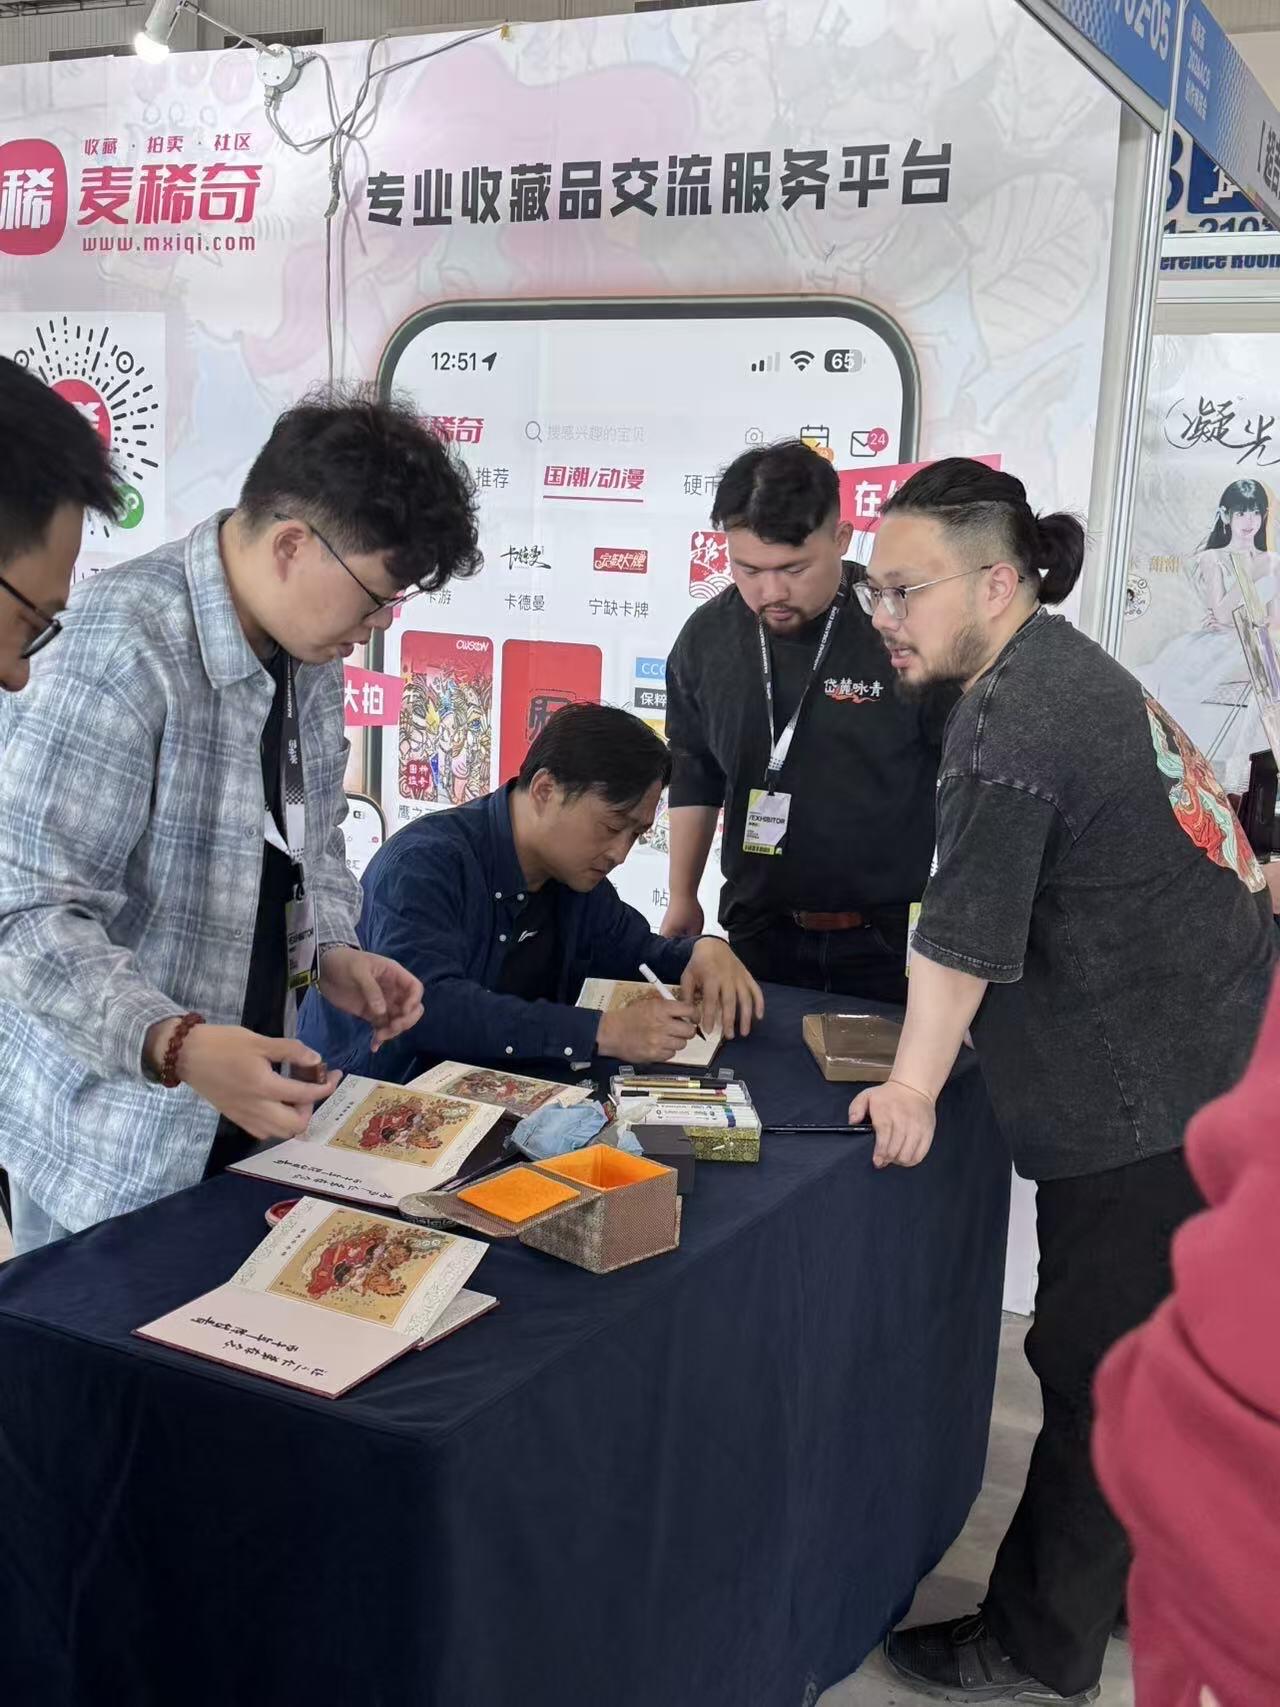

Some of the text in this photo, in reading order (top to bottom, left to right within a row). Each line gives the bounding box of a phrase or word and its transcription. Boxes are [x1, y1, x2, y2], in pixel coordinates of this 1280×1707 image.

[84, 133, 251, 155] 收藏 拍卖 社区
[366, 139, 953, 227] 专业收藏品交流服务平台
[0, 168, 55, 230] 稀
[77, 163, 263, 225] 麦稀奇
[82, 233, 256, 252] www.mxiqi.com
[431, 352, 477, 371] 12:51
[831, 353, 854, 369] 65
[547, 424, 645, 442] 搜感兴趣的宝贝
[870, 434, 886, 446] 24
[475, 467, 509, 489] 推荐
[544, 465, 645, 490] 国潮/动漫
[504, 593, 545, 612] 卡德曼
[589, 598, 649, 618] 宁缺卡牌
